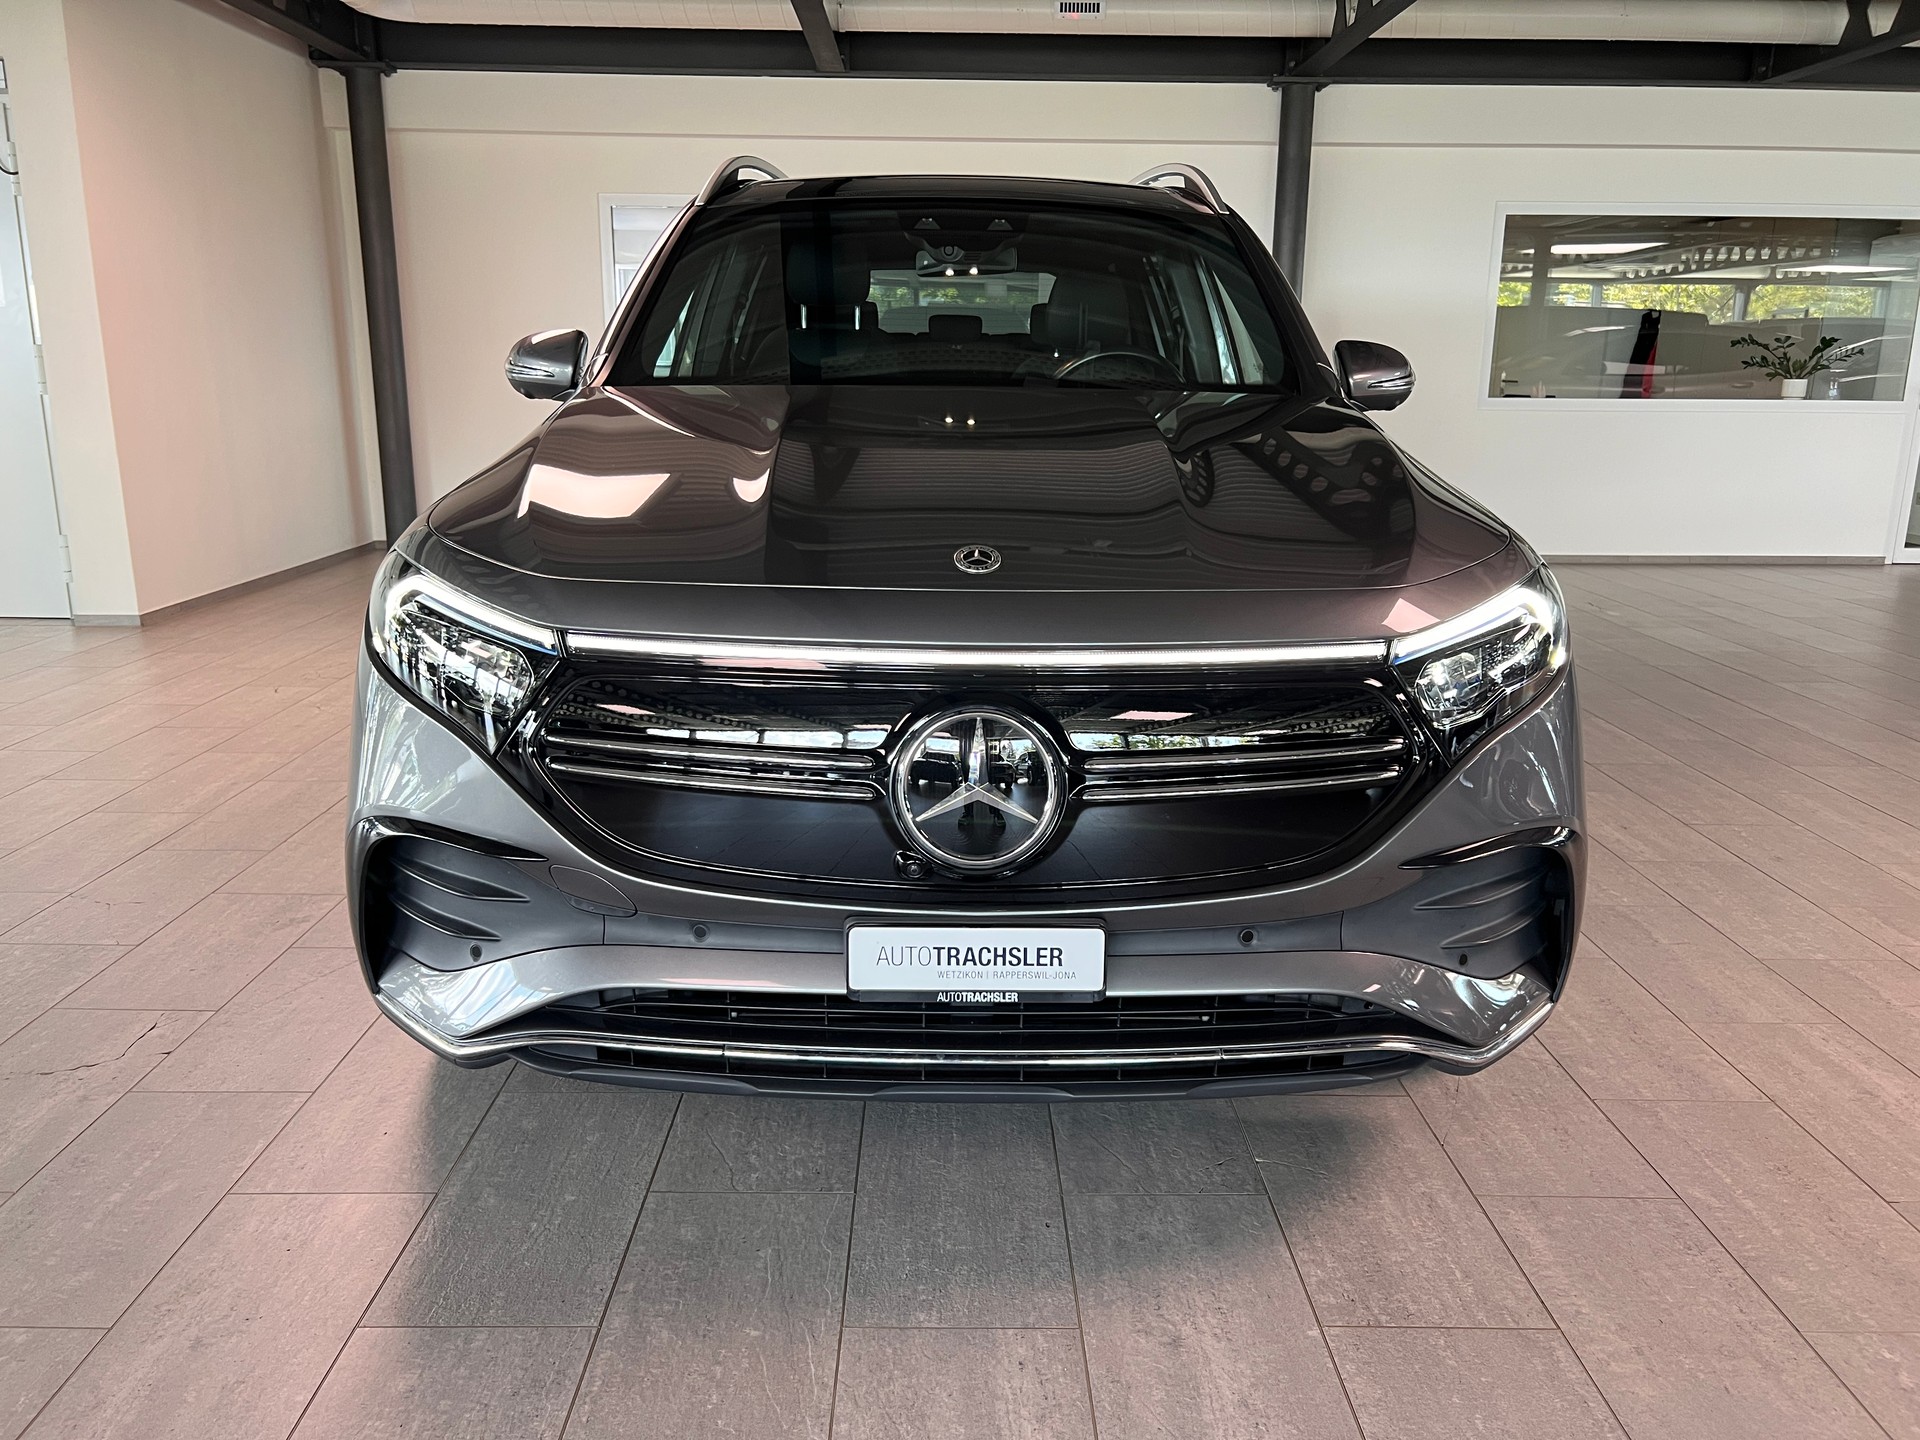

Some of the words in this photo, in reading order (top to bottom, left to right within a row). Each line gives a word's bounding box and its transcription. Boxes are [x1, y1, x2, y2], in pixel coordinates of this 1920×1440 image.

[876, 946, 1063, 966] AUTOTRACHSLER
[937, 971, 983, 979] WETZIKON
[992, 971, 1077, 980] RAPPERSWIL-JONA
[936, 992, 1019, 1002] AUTOTRACHSLER
